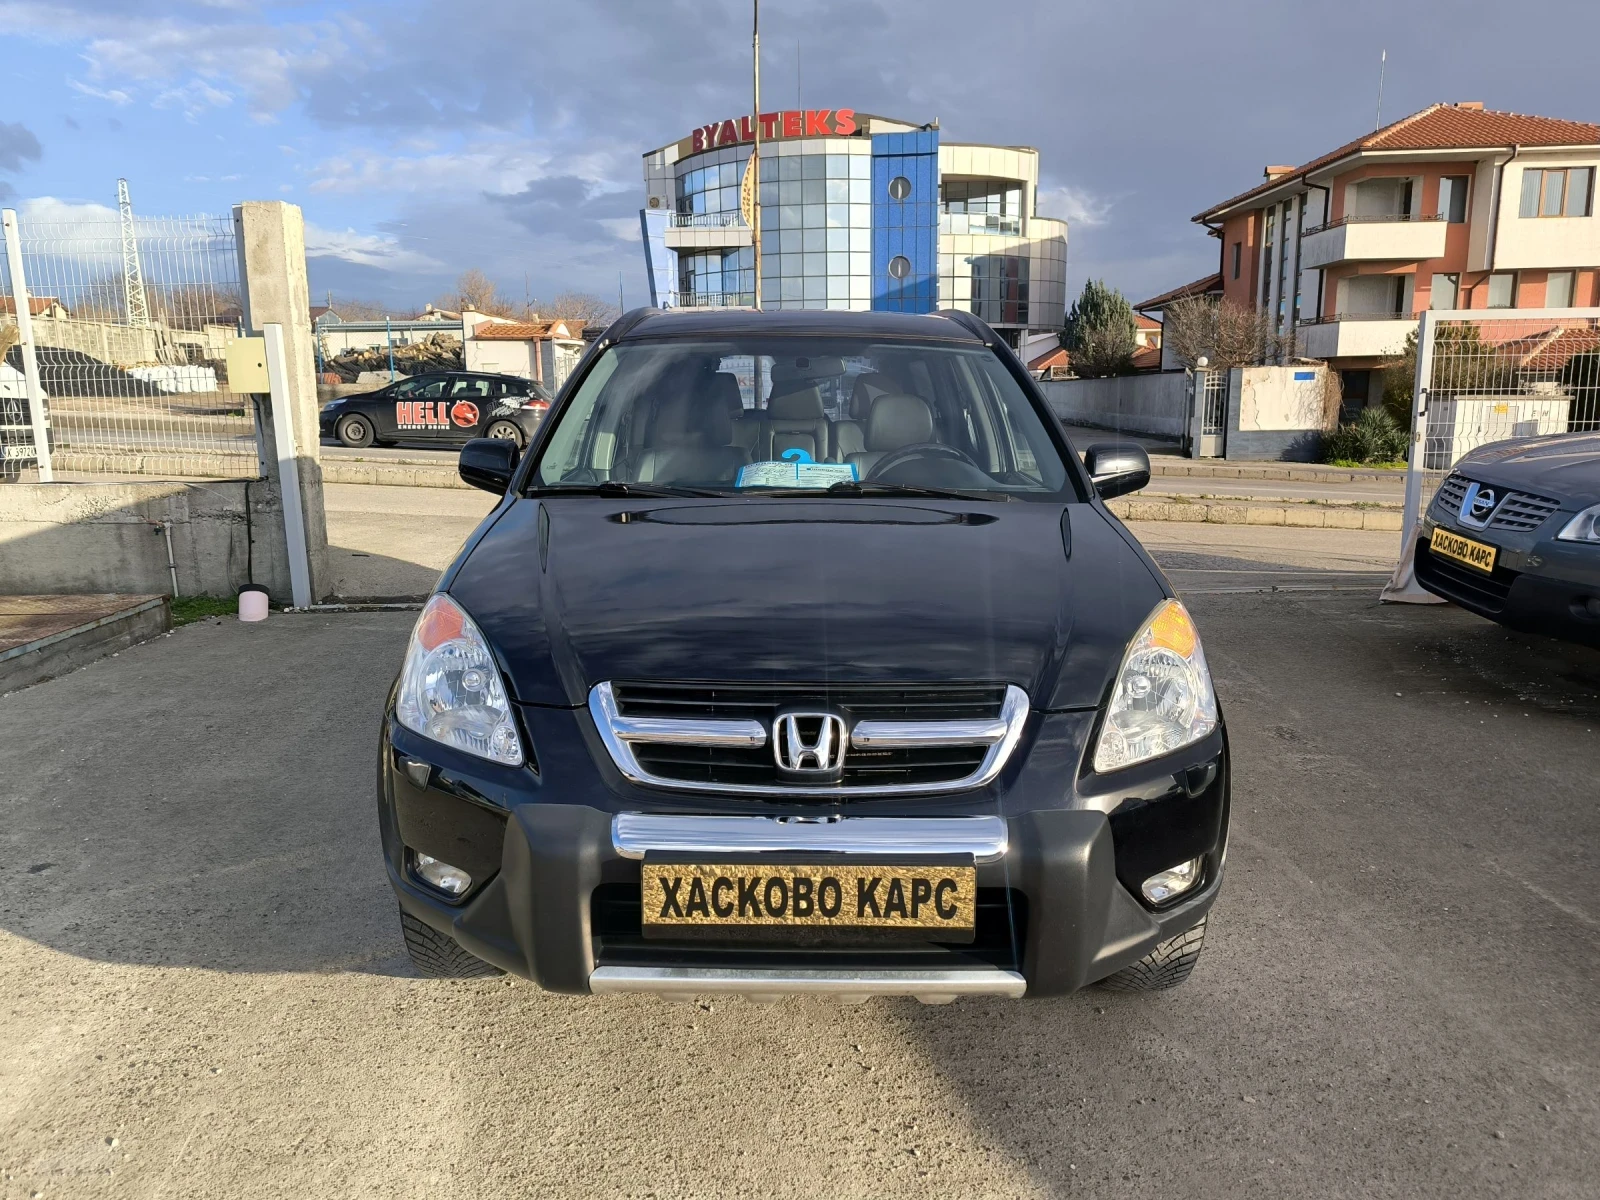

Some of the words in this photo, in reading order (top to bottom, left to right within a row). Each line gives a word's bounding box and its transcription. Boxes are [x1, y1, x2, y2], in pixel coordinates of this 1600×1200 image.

[692, 108, 857, 152] BYALTEKS
[396, 401, 450, 425] HELL
[1433, 532, 1468, 558] ХАСКОВО
[1469, 545, 1491, 567] КАРС
[658, 876, 842, 919] ХАСКОВО
[857, 877, 958, 920] КАРС
